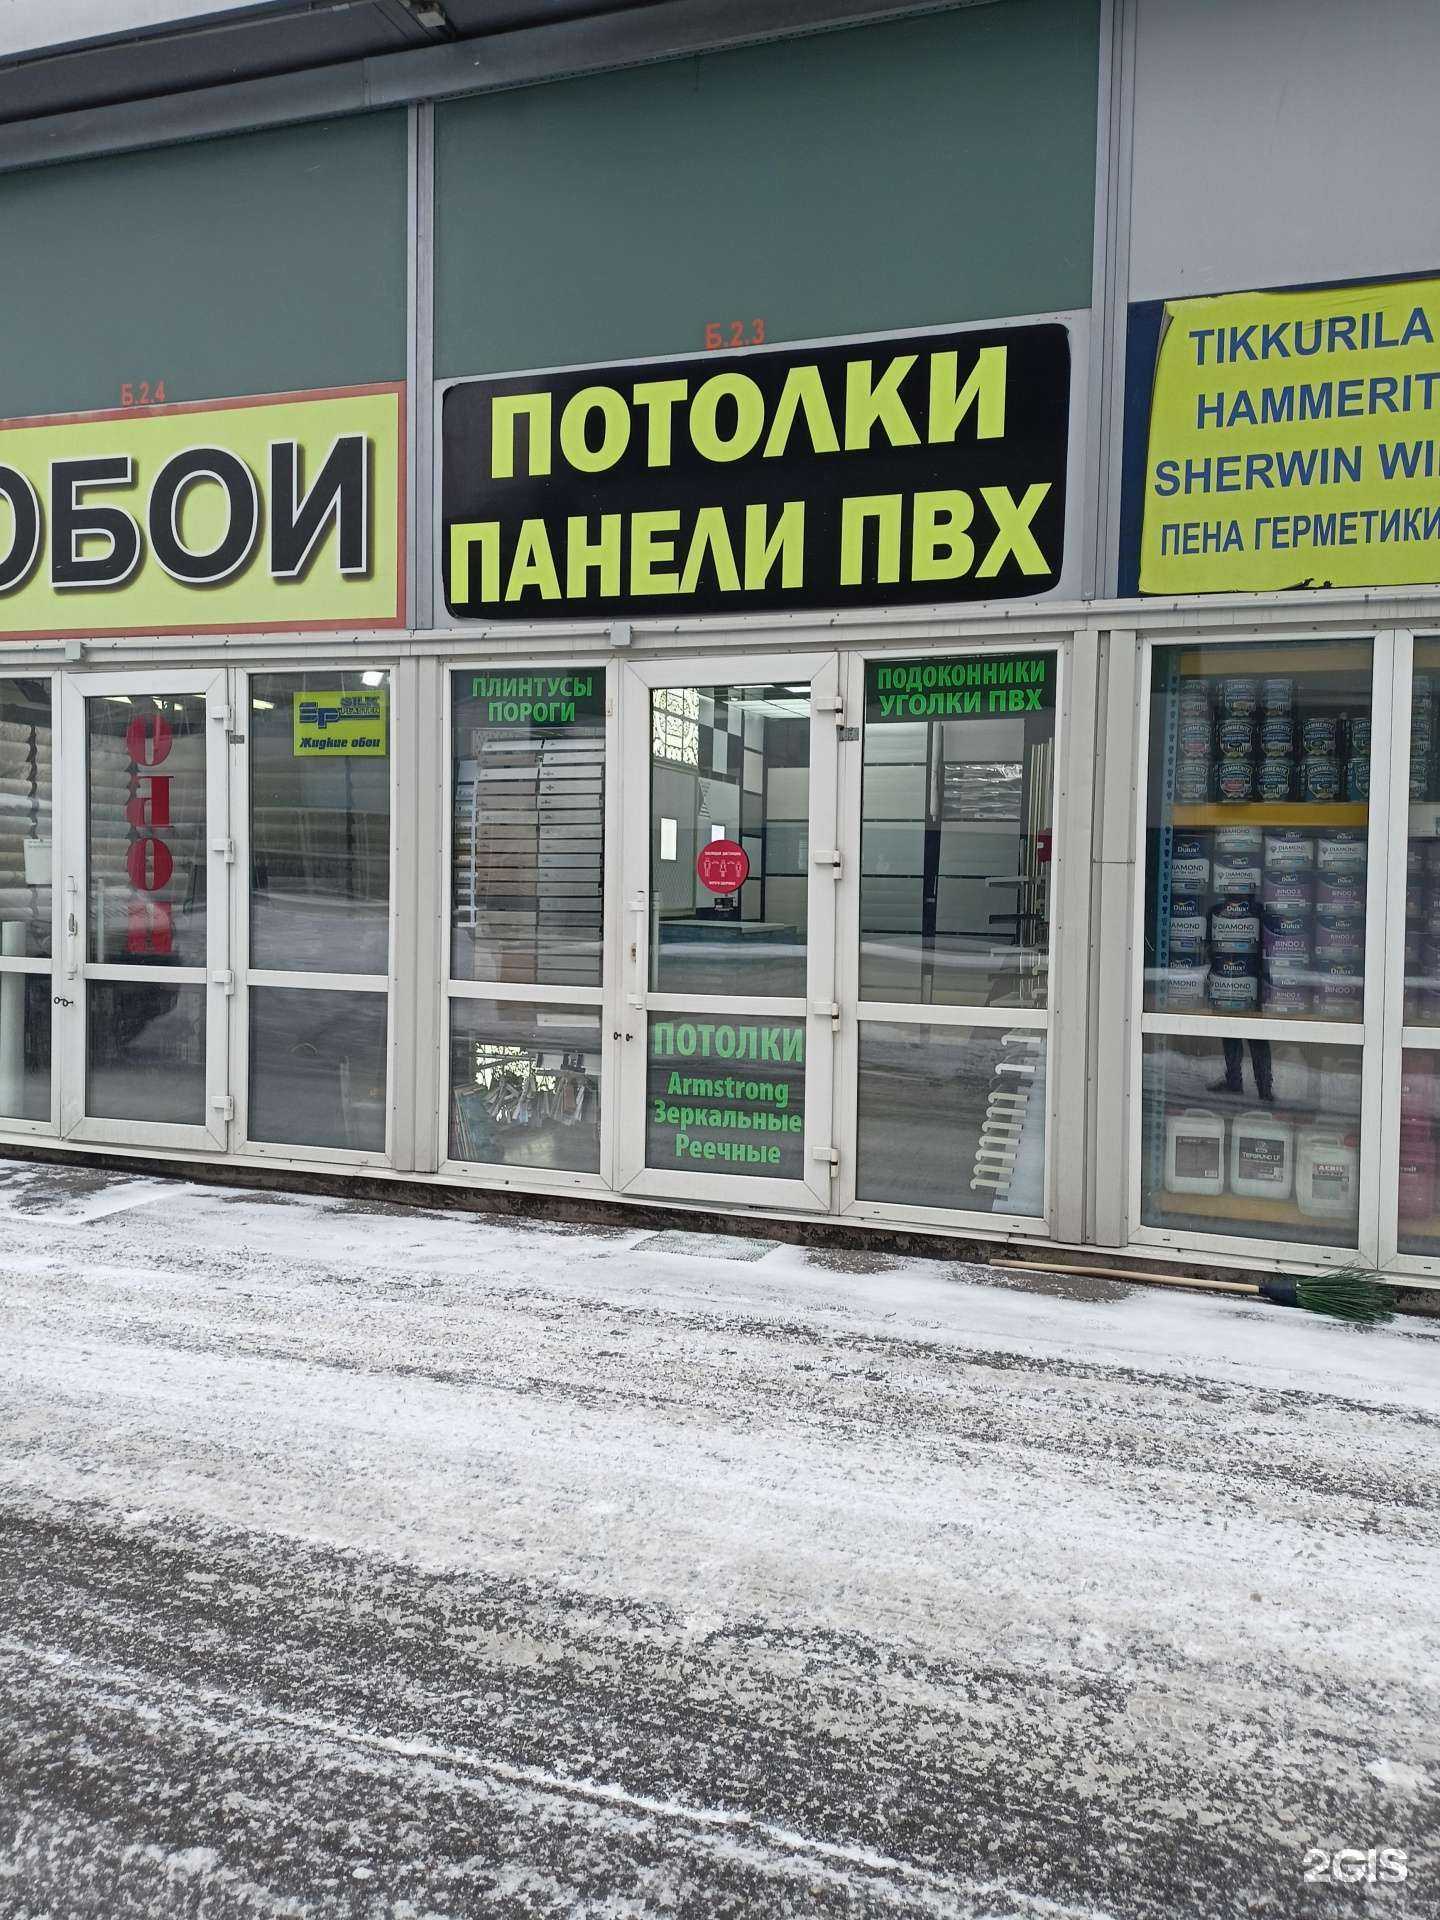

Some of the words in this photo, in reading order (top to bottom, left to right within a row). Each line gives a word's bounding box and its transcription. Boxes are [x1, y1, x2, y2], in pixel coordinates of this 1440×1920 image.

[1189, 307, 1434, 365] TIKKURILA
[490, 345, 1008, 479] ПОТОЛКИ
[1154, 445, 1362, 497] SHERWIN
[1378, 440, 1440, 480] WI
[450, 501, 805, 604] ПАНЕЛИ
[840, 482, 1053, 586] ПВХ
[1161, 519, 1245, 556] ПЕНА
[1255, 507, 1440, 550] ГЕРМЕТИКИ
[472, 676, 593, 697] ПЛИНТУСЫ
[878, 660, 1046, 692] ПОДОКОННИКИ
[488, 702, 576, 722] ПОРОГИ
[879, 691, 981, 717] УГОЛКИ
[989, 688, 1043, 713] ПВХ
[351, 736, 381, 748] обои
[653, 1022, 803, 1063] ПОТОЛКИ
[667, 1071, 789, 1108] Armstrong
[654, 1099, 802, 1132] Зеркальные
[675, 1133, 781, 1164] Реечные
